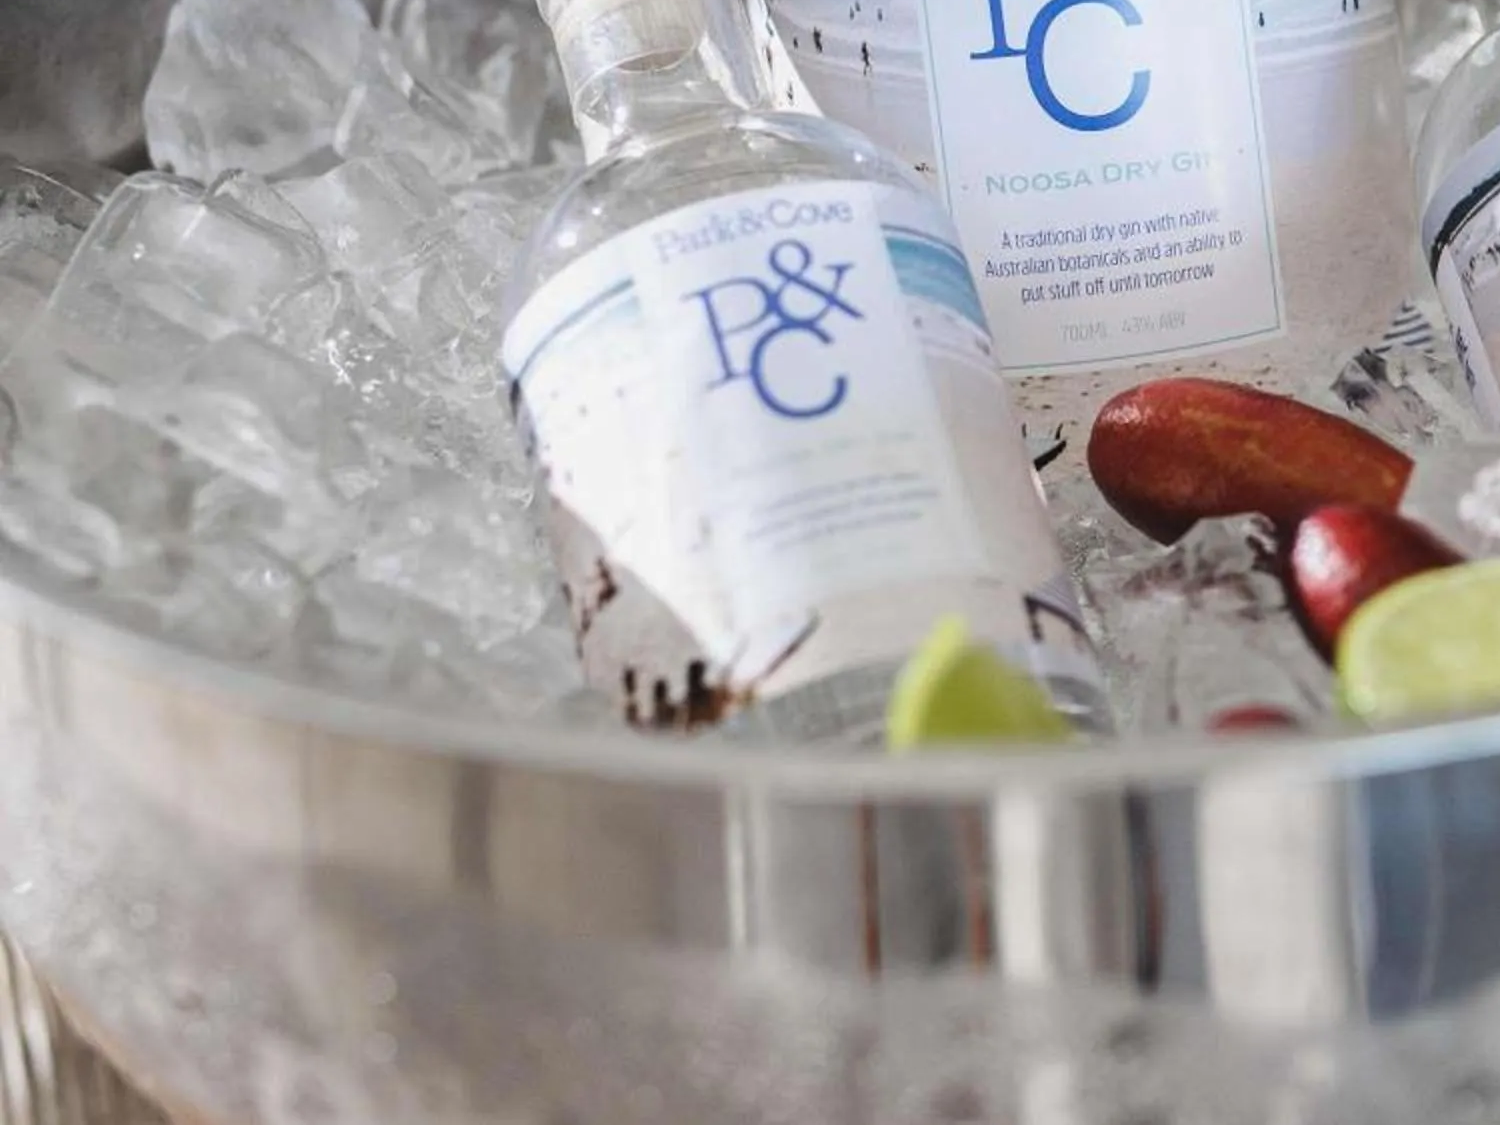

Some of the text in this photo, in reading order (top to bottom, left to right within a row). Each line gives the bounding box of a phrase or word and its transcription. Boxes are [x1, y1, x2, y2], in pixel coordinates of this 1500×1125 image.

[984, 168, 1093, 196] NOOSA
[1102, 159, 1163, 184] DRY
[1001, 230, 1013, 251] A
[1014, 225, 1088, 249] traditional
[1089, 222, 1114, 243] dry
[1118, 219, 1142, 241] gin
[1143, 213, 1178, 234] with
[984, 228, 1243, 278] Australian botanicals and an ability to
[1020, 262, 1216, 305] put stuff off until tomorrow
